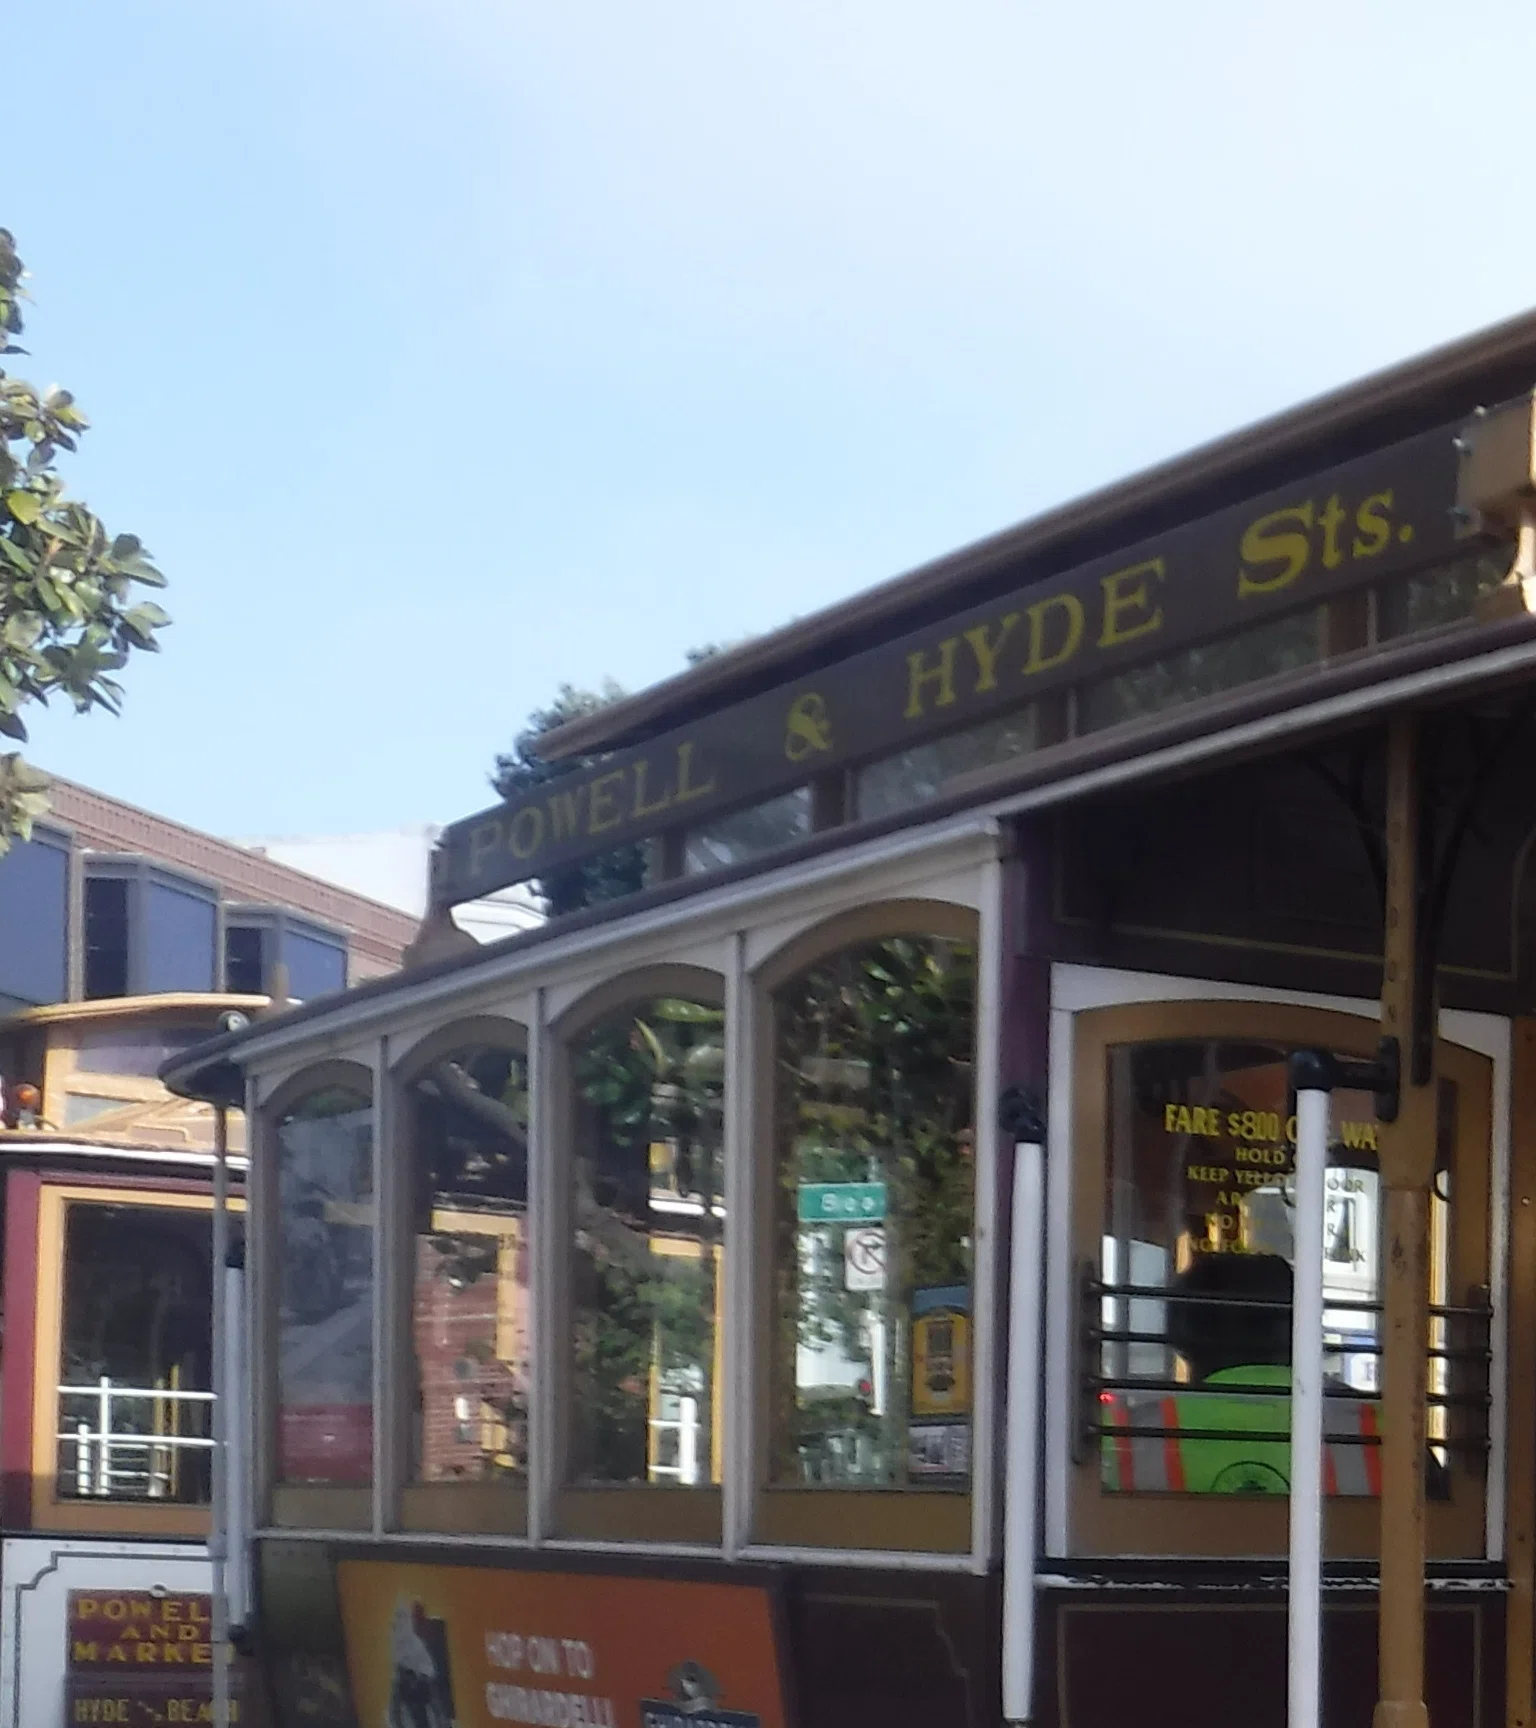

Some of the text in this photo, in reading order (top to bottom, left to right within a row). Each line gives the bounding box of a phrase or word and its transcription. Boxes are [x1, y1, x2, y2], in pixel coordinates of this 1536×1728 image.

[467, 489, 1416, 878] POWELL & HYDE Sts.
[1164, 1103, 1221, 1136] FARE
[1341, 1120, 1378, 1151] WA
[1235, 1147, 1286, 1165] HOLD
[1187, 1165, 1230, 1182] KEEP
[76, 1599, 211, 1622] POWEL
[120, 1624, 199, 1641] AND
[484, 1631, 596, 1680] HOP ON TO
